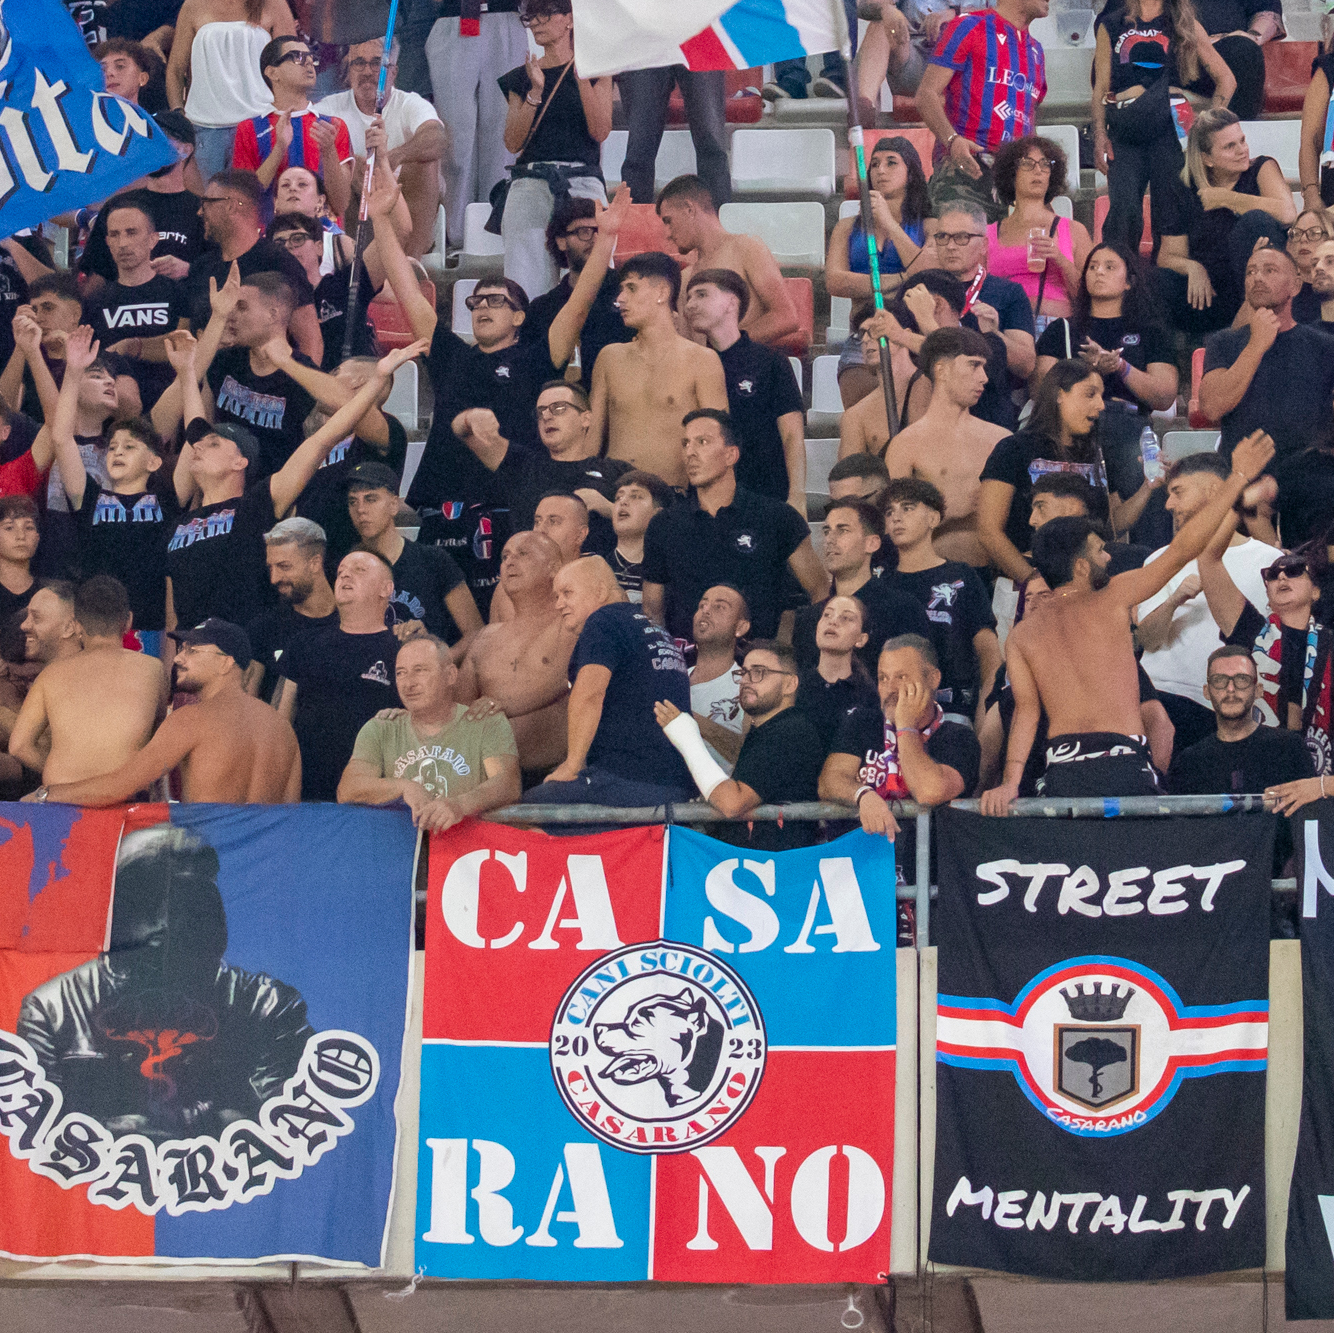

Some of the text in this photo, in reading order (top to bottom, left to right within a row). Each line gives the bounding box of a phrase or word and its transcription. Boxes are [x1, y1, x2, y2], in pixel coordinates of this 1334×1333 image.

[989, 66, 1027, 92] LEO
[103, 302, 170, 329] VANS
[440, 847, 882, 956] CA SA
[974, 857, 1248, 919] STREET
[565, 950, 752, 1030] CANI SCIOLTI
[553, 1032, 763, 1061] 20 23
[566, 1068, 748, 1145] CASARANO
[1045, 1104, 1148, 1135] CASARANO
[421, 1137, 887, 1254] RA NO
[944, 1175, 1252, 1235] MENTALITY
